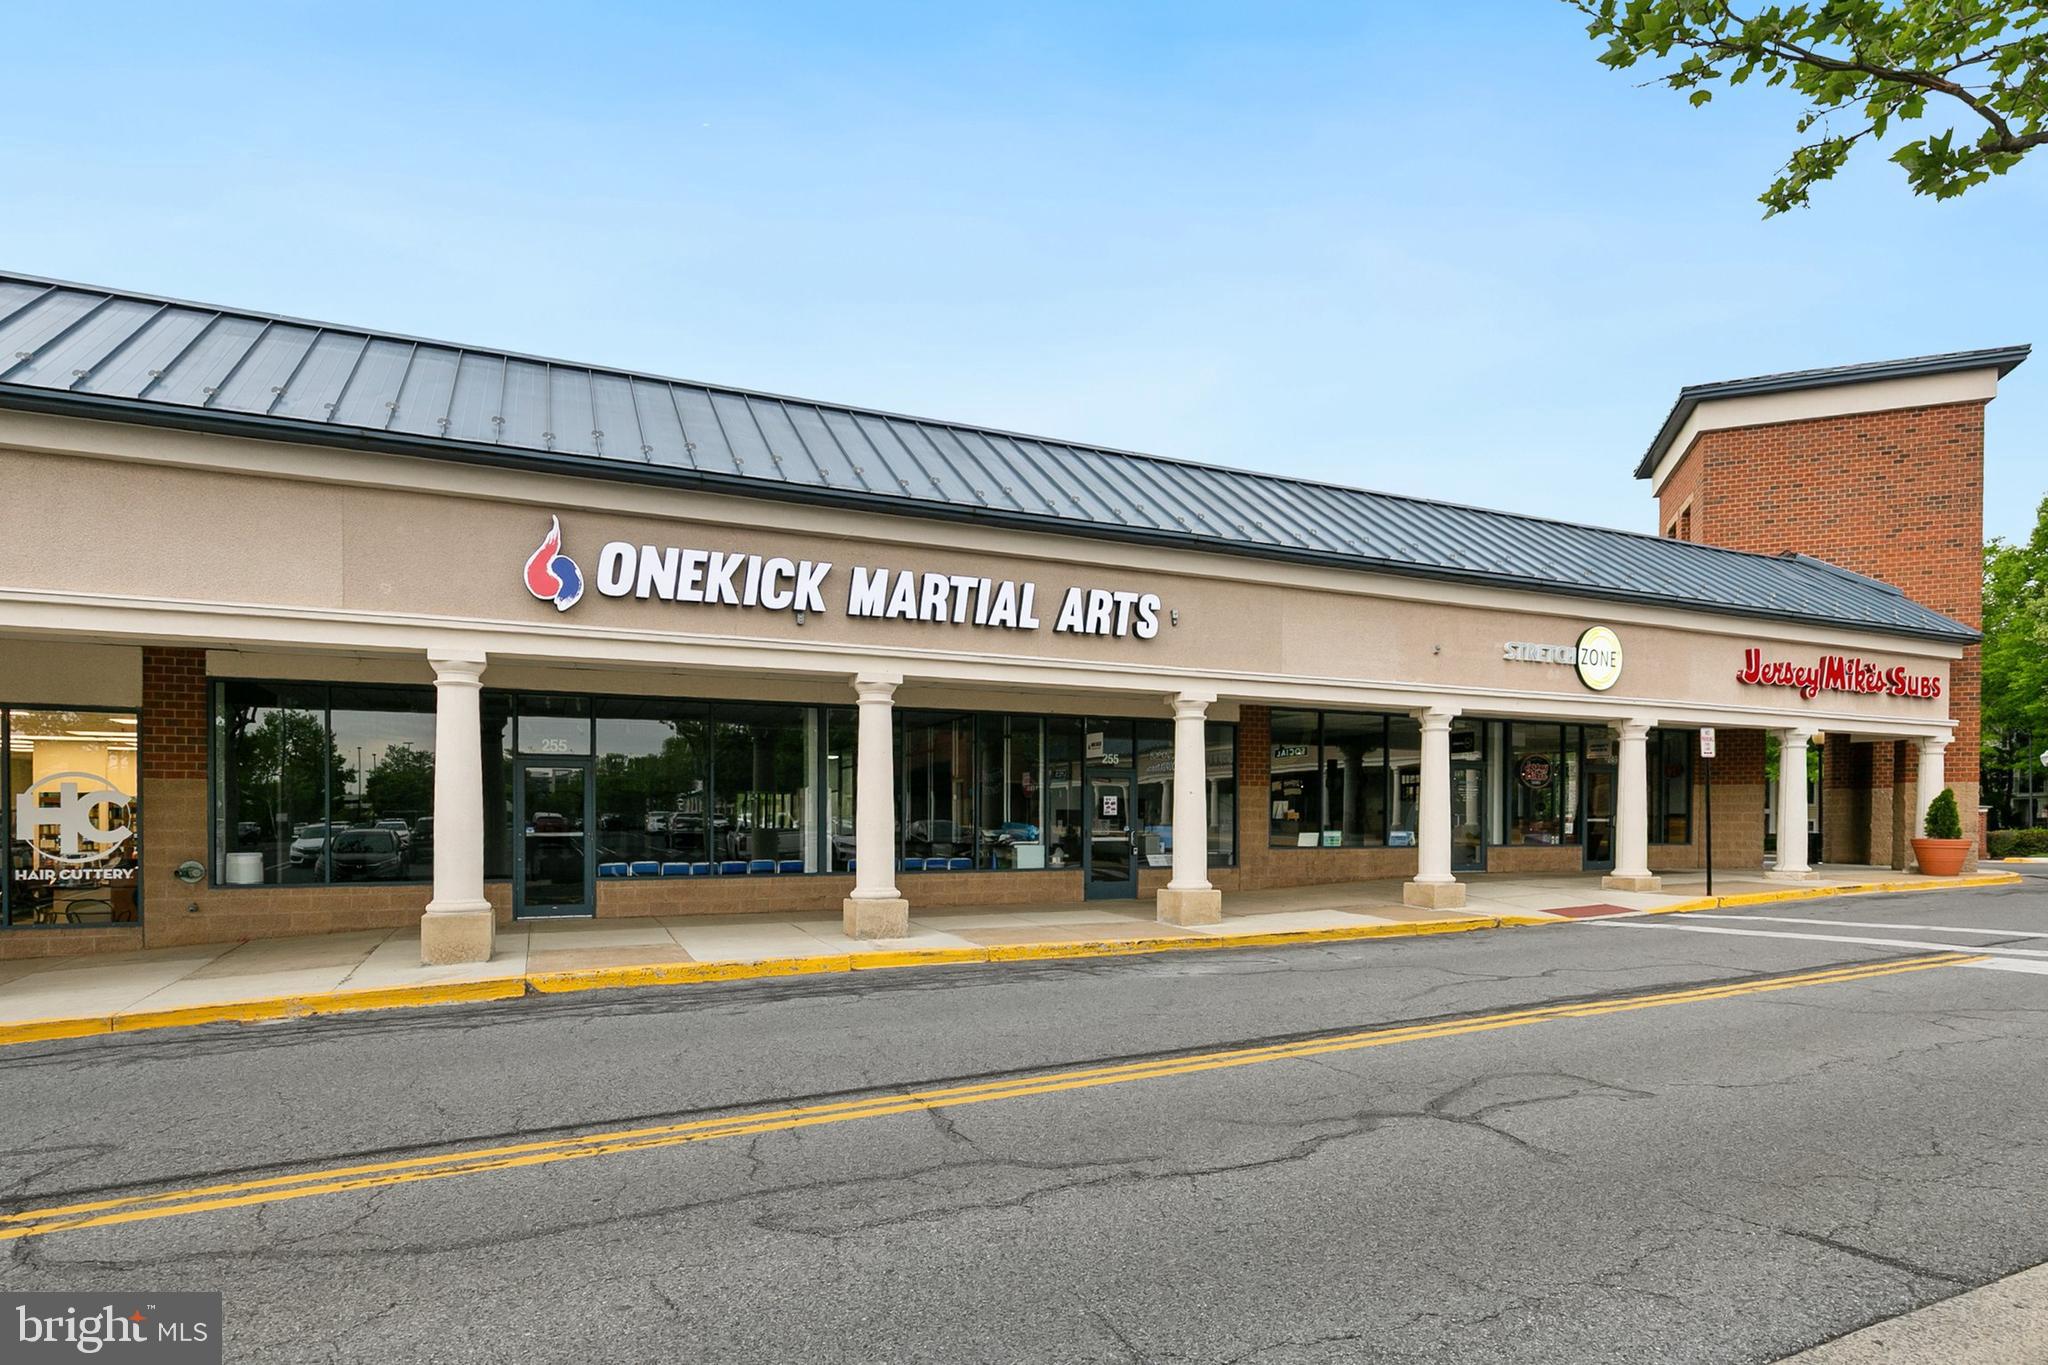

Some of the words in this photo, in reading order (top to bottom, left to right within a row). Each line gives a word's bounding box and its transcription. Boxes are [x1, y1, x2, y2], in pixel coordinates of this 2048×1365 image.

[596, 541, 833, 614] ONEKICK
[847, 566, 1041, 632] MARTIAL
[1055, 587, 1162, 640] ARTS
[1580, 648, 1617, 668] ZONE
[1737, 648, 1820, 700] Jersey
[1819, 655, 1888, 694] Mike's
[541, 738, 568, 751] 255
[1102, 753, 1119, 764] 255
[15, 869, 56, 881] HAIR
[59, 868, 134, 880] CUTTERY
